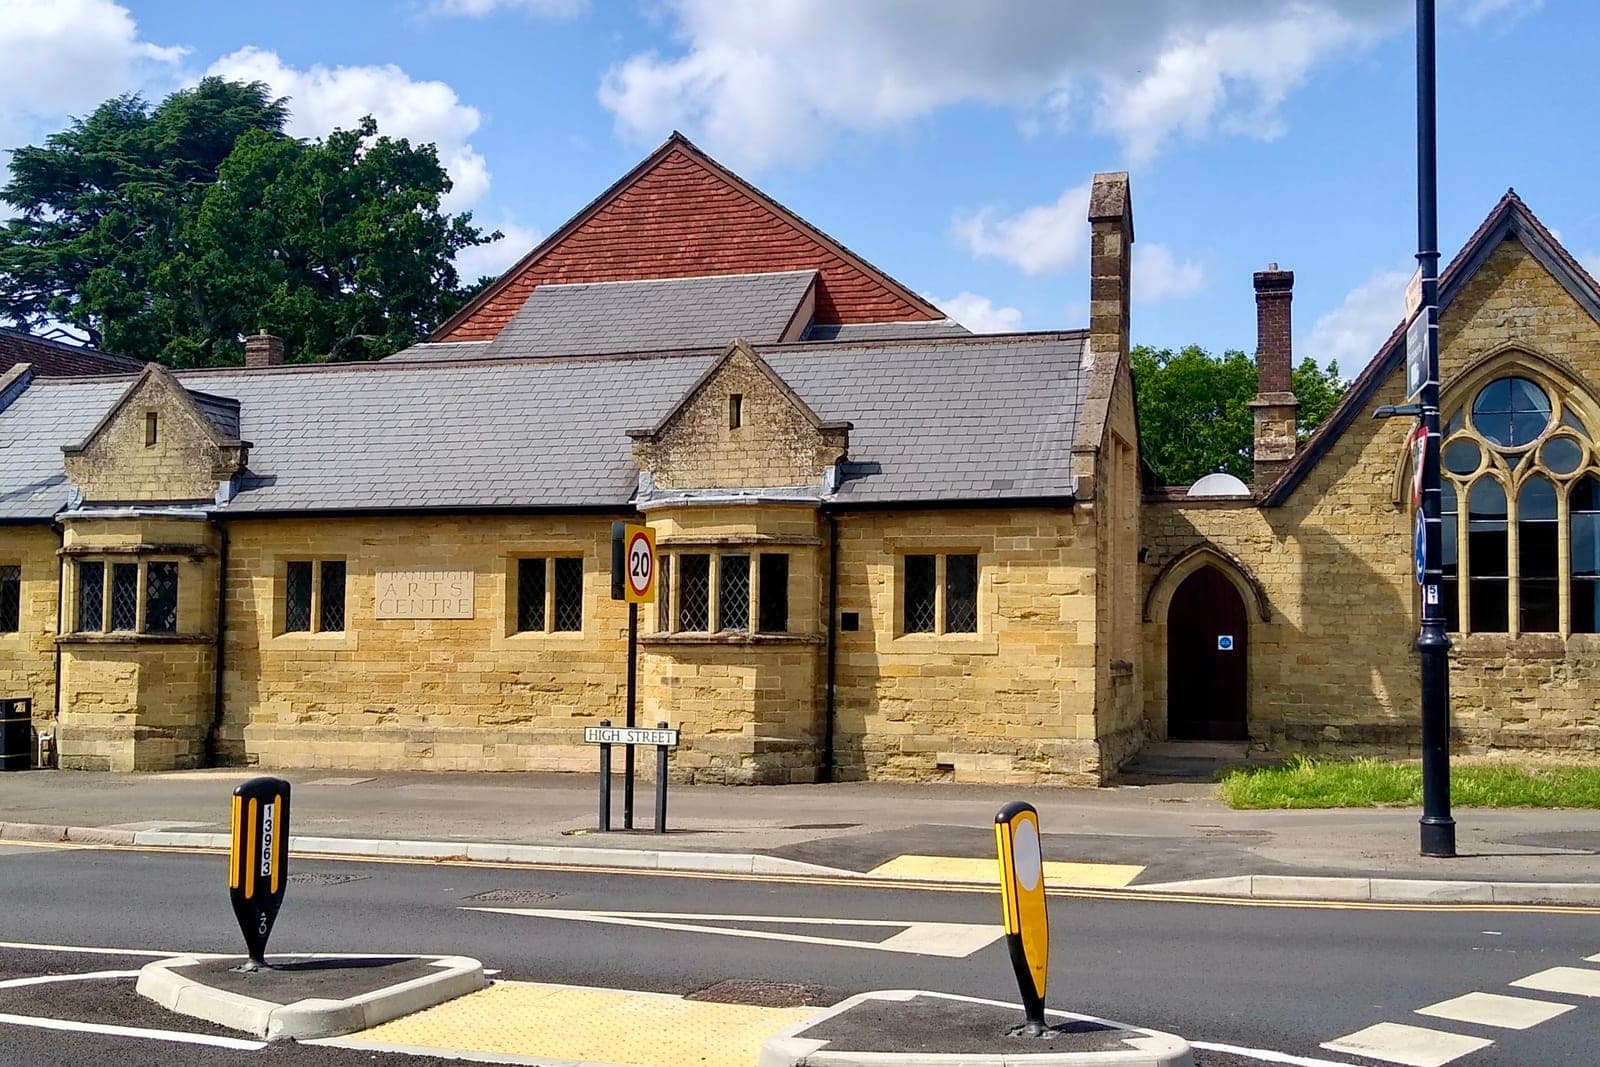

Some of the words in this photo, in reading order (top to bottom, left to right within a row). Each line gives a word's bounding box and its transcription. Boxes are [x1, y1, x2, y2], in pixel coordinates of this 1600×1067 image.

[631, 551, 650, 577] 20
[384, 582, 463, 597] ARTS
[379, 598, 470, 614] CENTRE
[588, 728, 620, 742] HIGH
[627, 730, 673, 743] STREET
[262, 805, 273, 875] 13963
